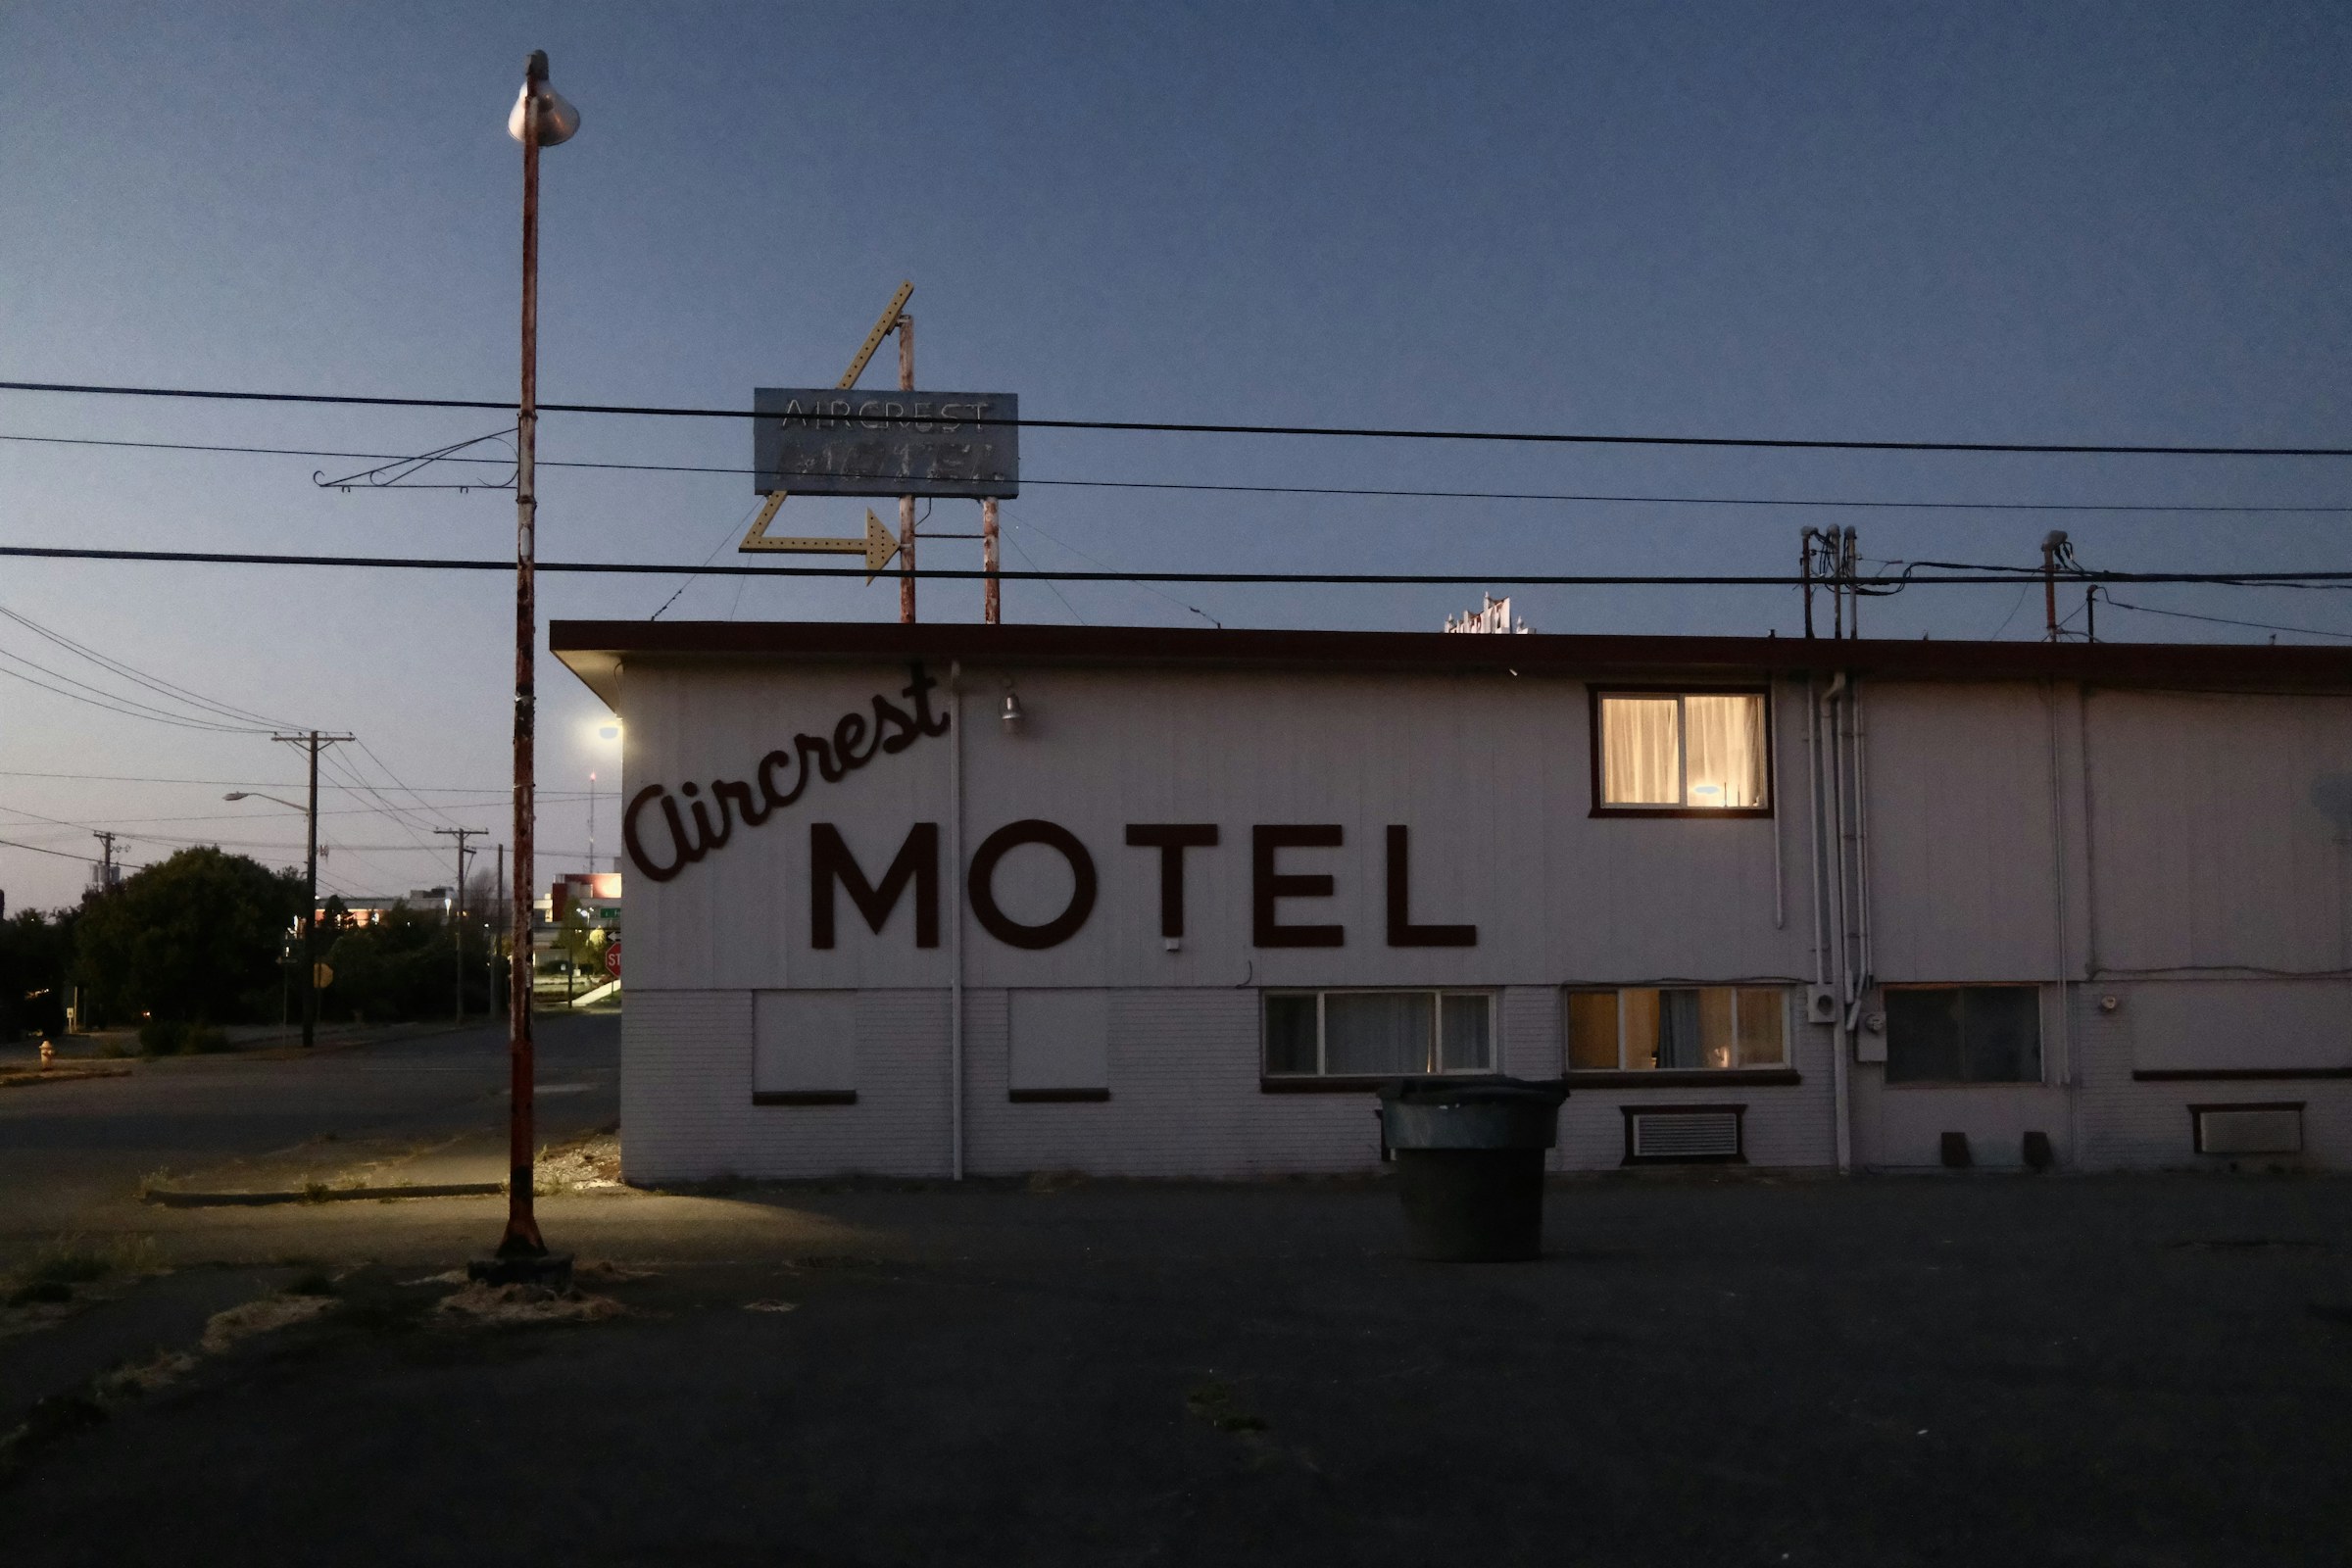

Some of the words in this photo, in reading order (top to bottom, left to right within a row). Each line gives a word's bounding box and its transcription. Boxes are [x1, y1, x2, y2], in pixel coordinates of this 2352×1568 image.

[782, 399, 989, 431] AIRCREST
[623, 663, 950, 882] Aircrest
[810, 819, 1478, 949] MOTEL
[608, 955, 621, 966] ST
